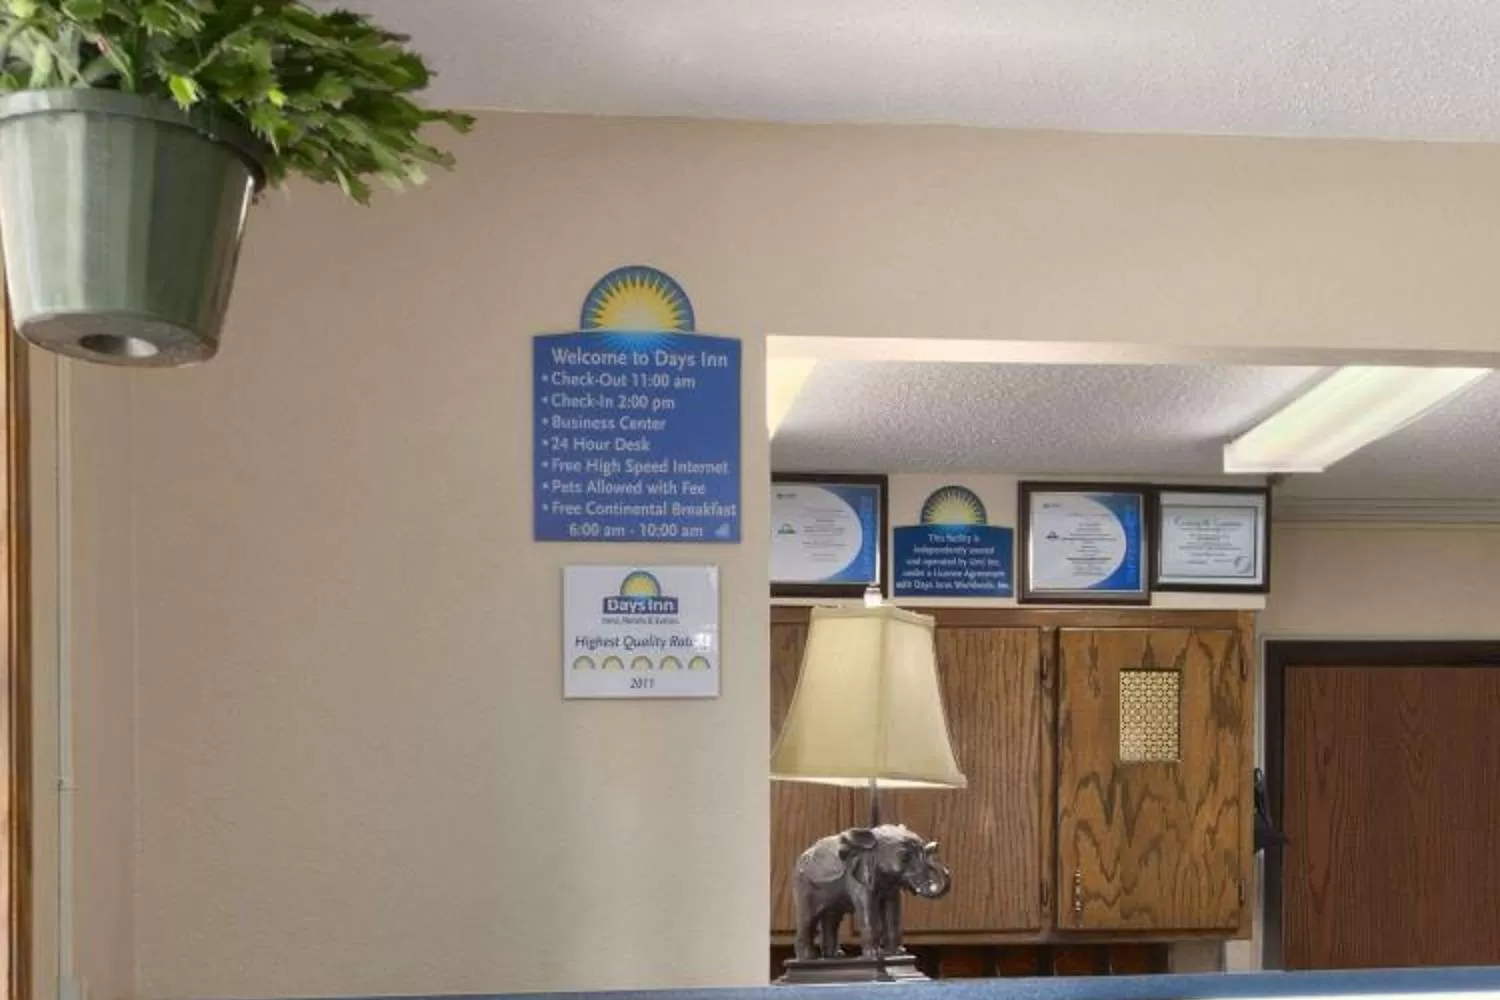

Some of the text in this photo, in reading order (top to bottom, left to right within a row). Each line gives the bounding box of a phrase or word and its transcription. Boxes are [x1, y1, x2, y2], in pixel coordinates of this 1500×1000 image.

[551, 347, 728, 370] Welcome to Days Inn
[551, 372, 696, 389] Check-Out 11:00 am
[551, 393, 675, 412] Check-In 2:00 pm
[551, 415, 667, 431] Business Center
[551, 436, 651, 451] 24 Hour Desk
[551, 458, 728, 476] Free High Speed Internet
[551, 480, 705, 496] Pets Allowed with Fee
[551, 501, 737, 517] Free Continental Breakfast
[569, 523, 599, 537] 6:00
[604, 525, 625, 537] am
[640, 523, 677, 537] 10:00
[681, 525, 704, 538] am
[607, 598, 675, 614] Days Inn
[575, 635, 620, 651] Highest
[623, 635, 667, 651] Quality
